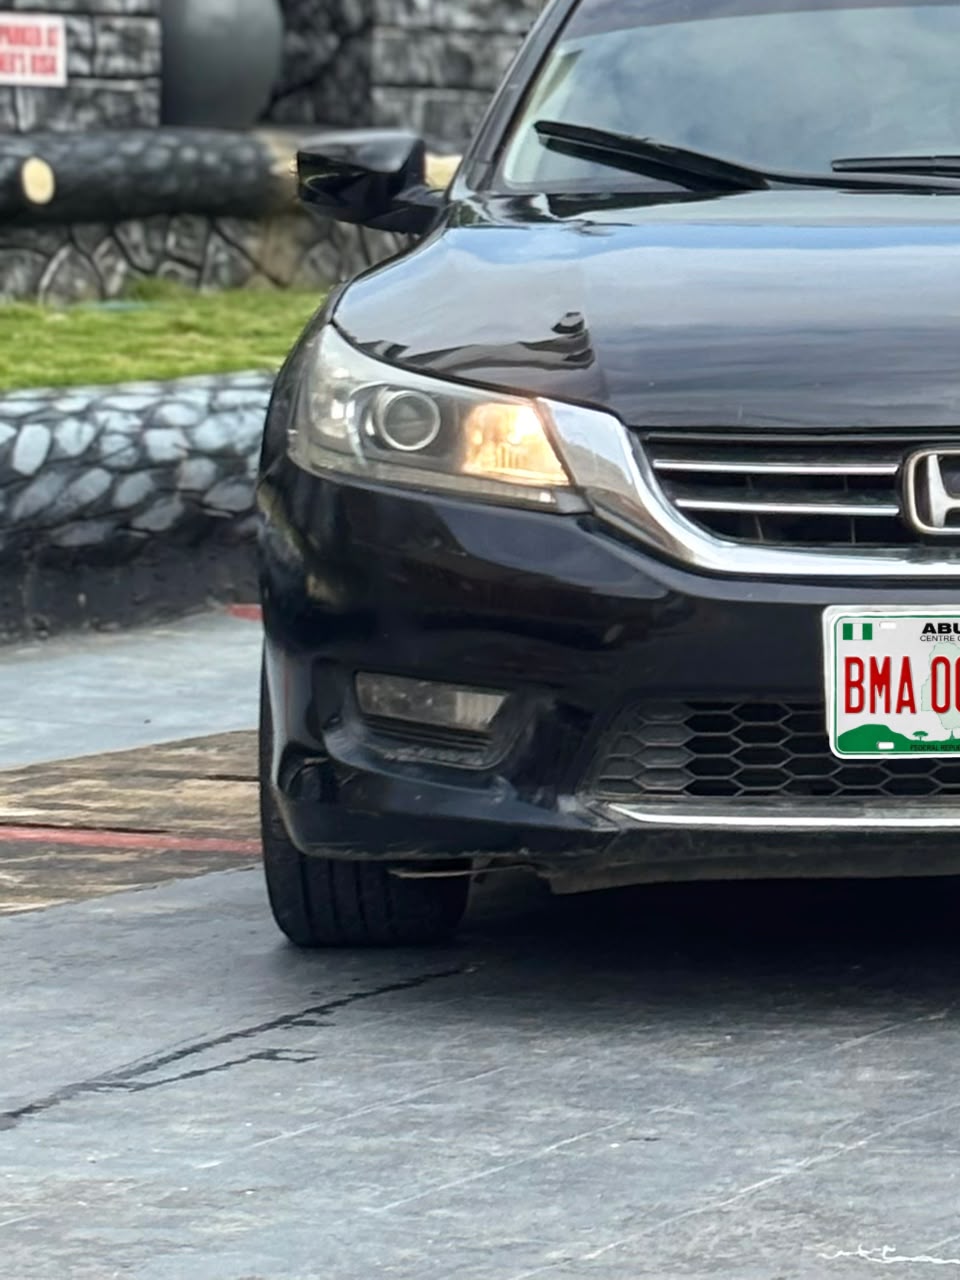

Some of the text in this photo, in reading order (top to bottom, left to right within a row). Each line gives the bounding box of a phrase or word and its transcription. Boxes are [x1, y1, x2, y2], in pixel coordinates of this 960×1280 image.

[920, 634, 955, 642] CENTRE
[844, 656, 917, 714] BMA
[910, 744, 938, 752] FEDERAL
